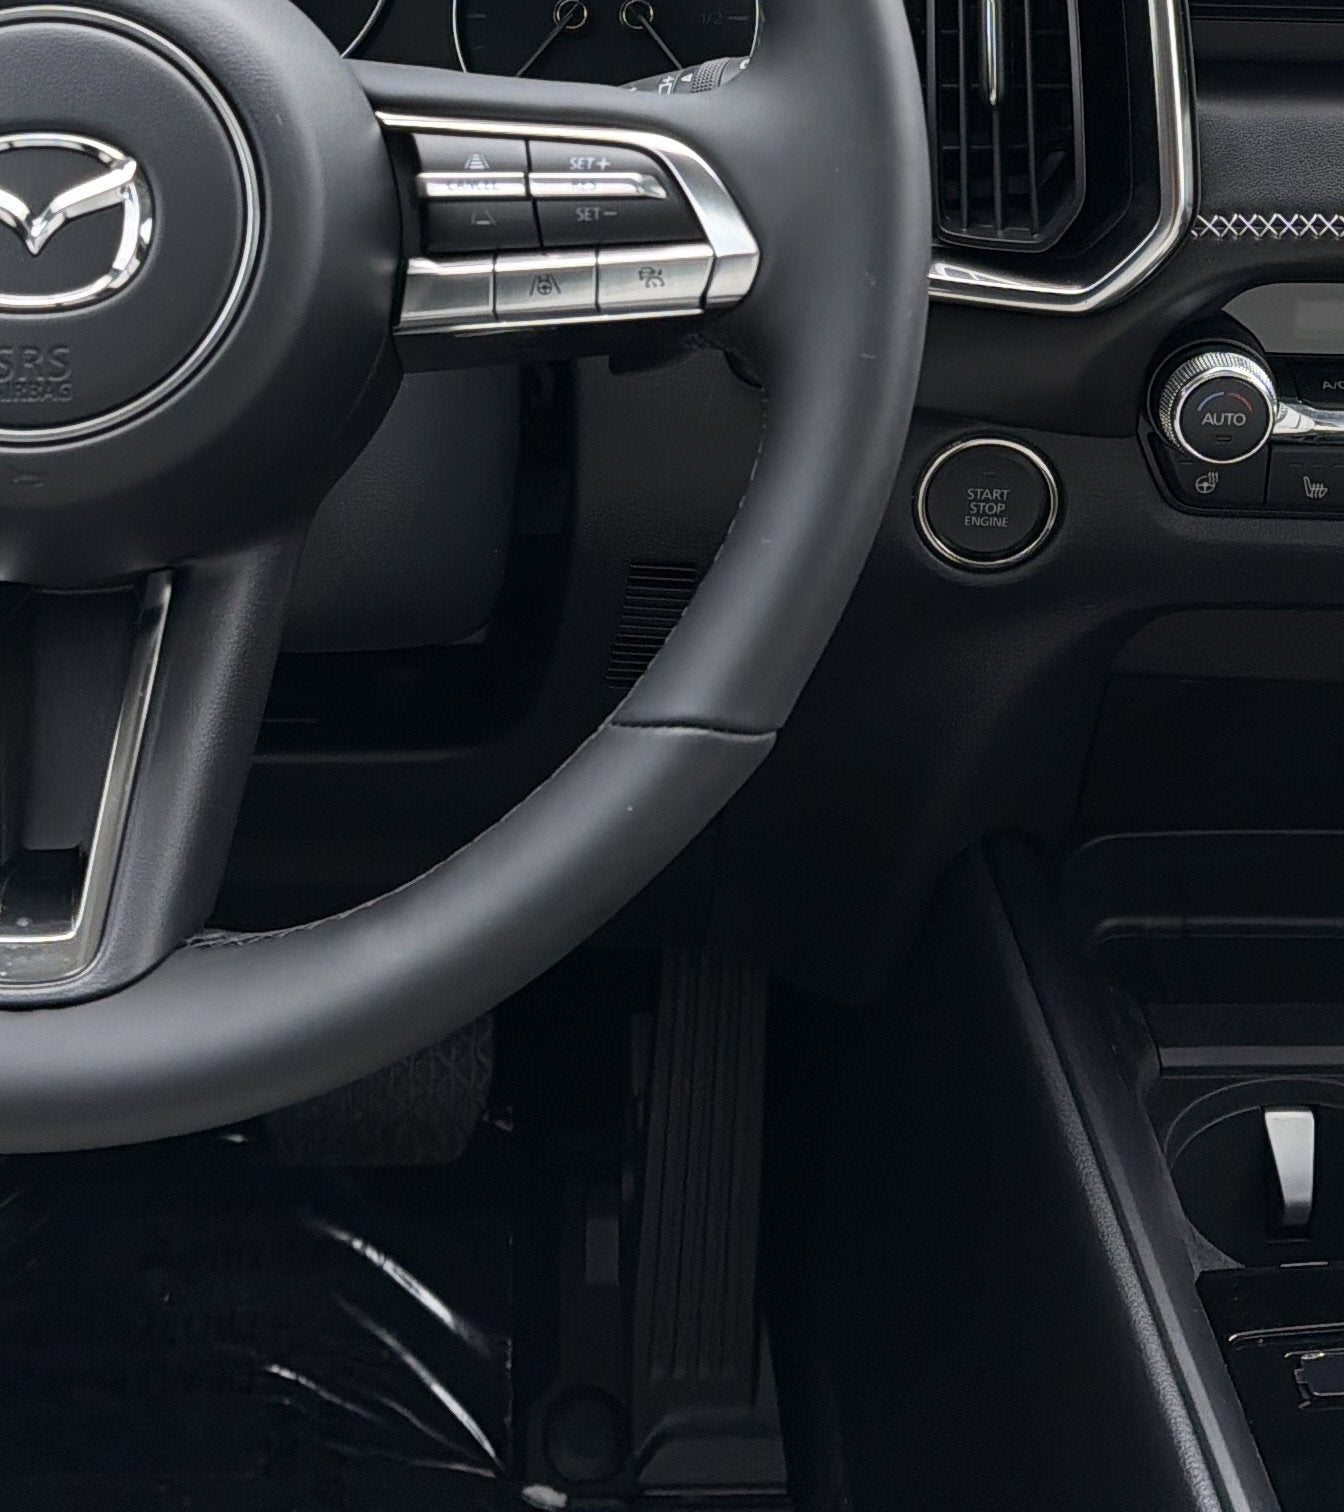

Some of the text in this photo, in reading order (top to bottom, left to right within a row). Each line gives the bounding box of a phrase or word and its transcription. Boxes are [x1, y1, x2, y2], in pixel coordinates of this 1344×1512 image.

[1201, 411, 1247, 427] AUTO
[967, 488, 1010, 500] START
[970, 503, 1006, 515] STOP
[964, 516, 1009, 528] ENGINE
